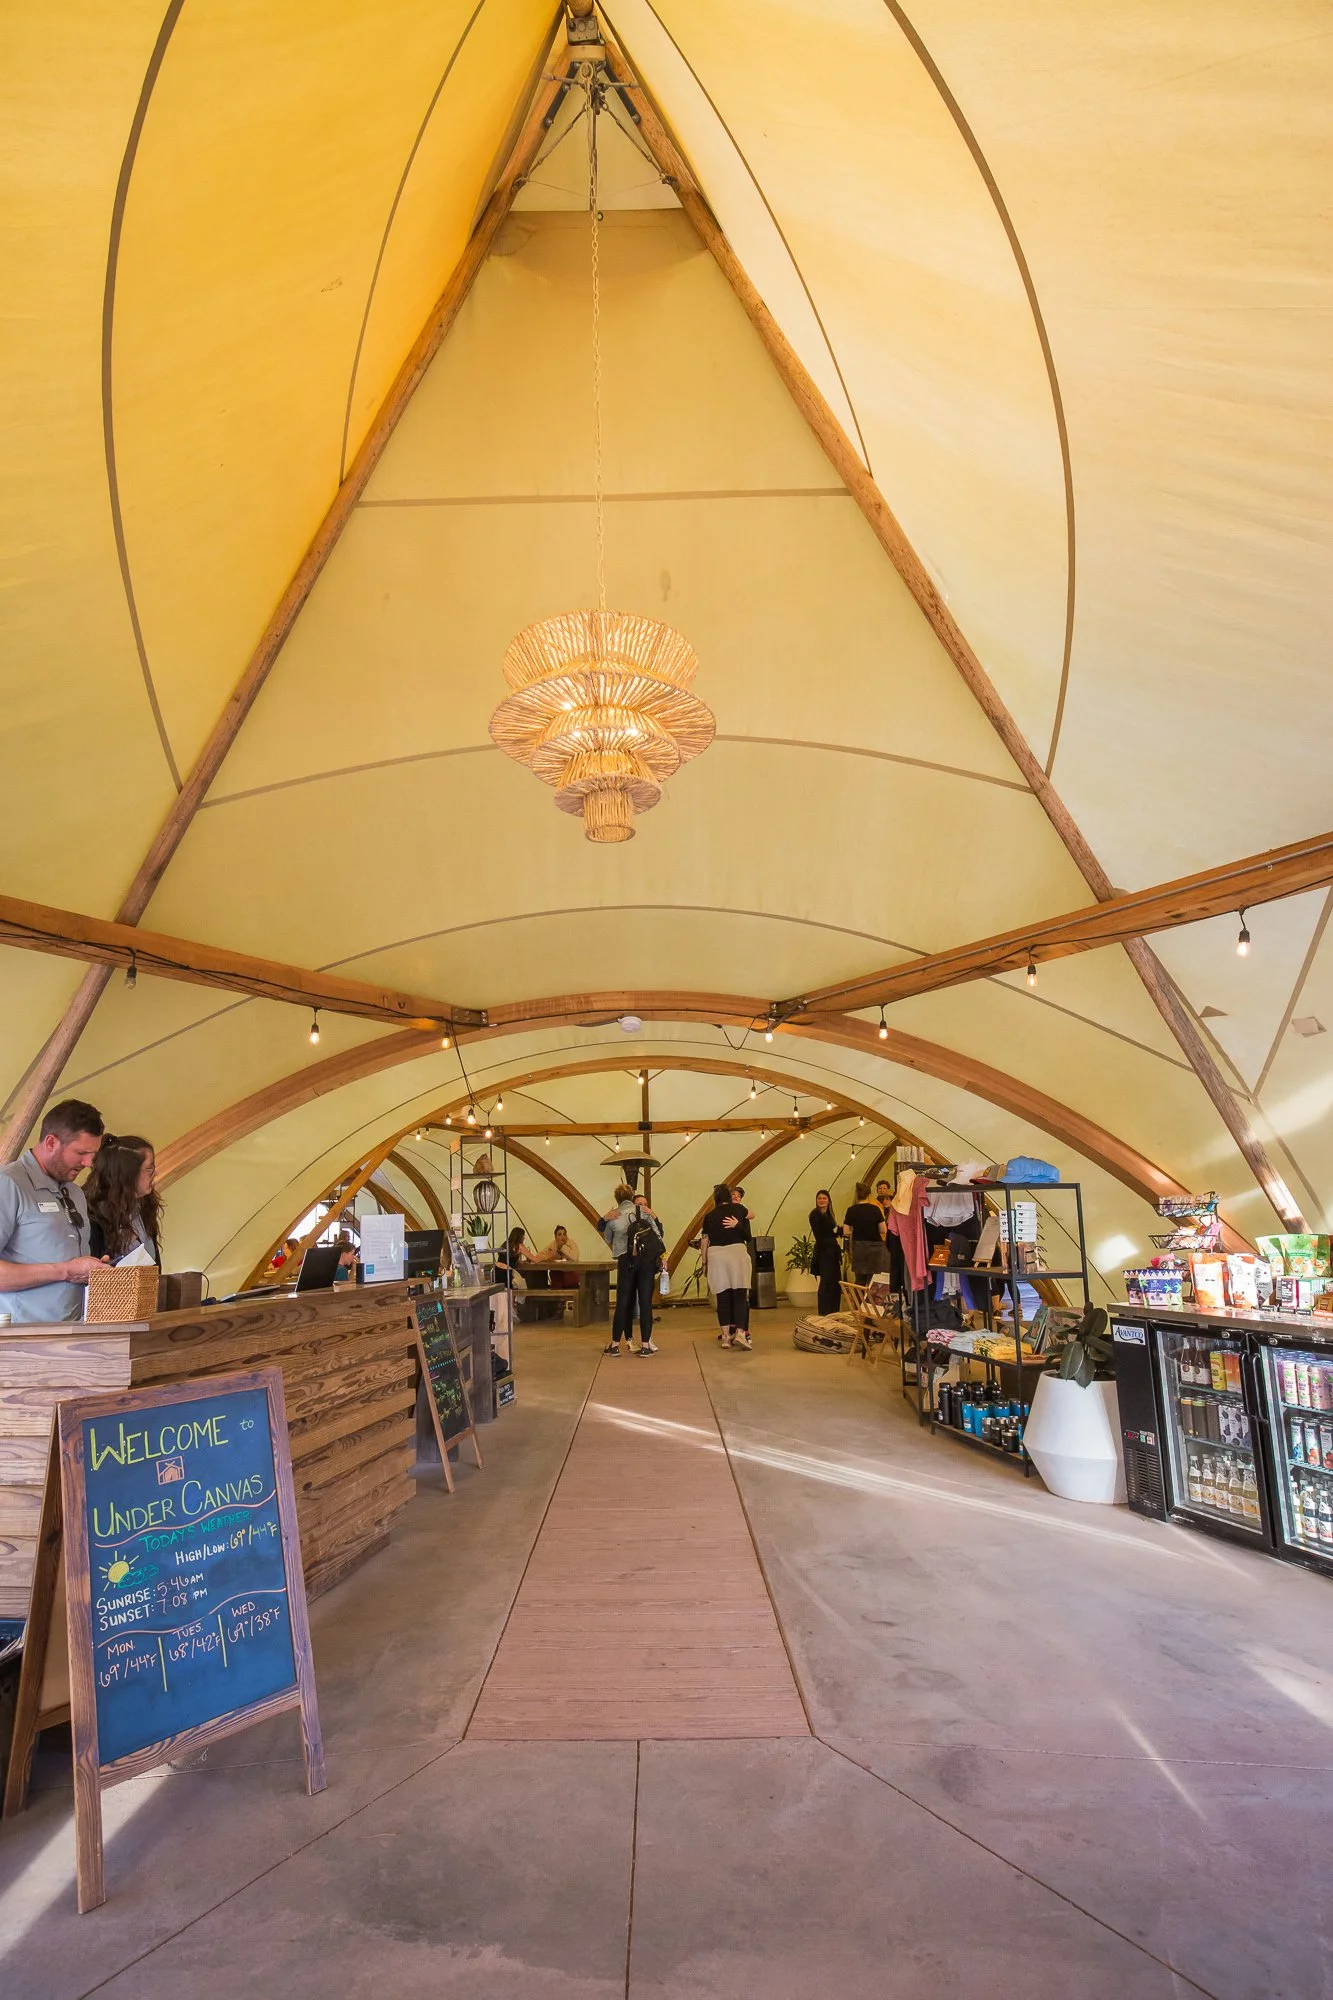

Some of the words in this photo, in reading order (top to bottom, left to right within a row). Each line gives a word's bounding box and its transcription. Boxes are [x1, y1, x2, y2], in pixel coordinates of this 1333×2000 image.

[1114, 1326, 1144, 1340] AVANTCO
[89, 1415, 229, 1471] WELCOME
[239, 1418, 255, 1430] to
[93, 1498, 176, 1537] UNDER
[181, 1474, 263, 1516] CANVAS
[201, 1510, 250, 1533] WEATHER
[96, 1587, 156, 1615] SUNRISE:
[99, 1603, 155, 1631] SUNSET:
[192, 1587, 208, 1600] PM
